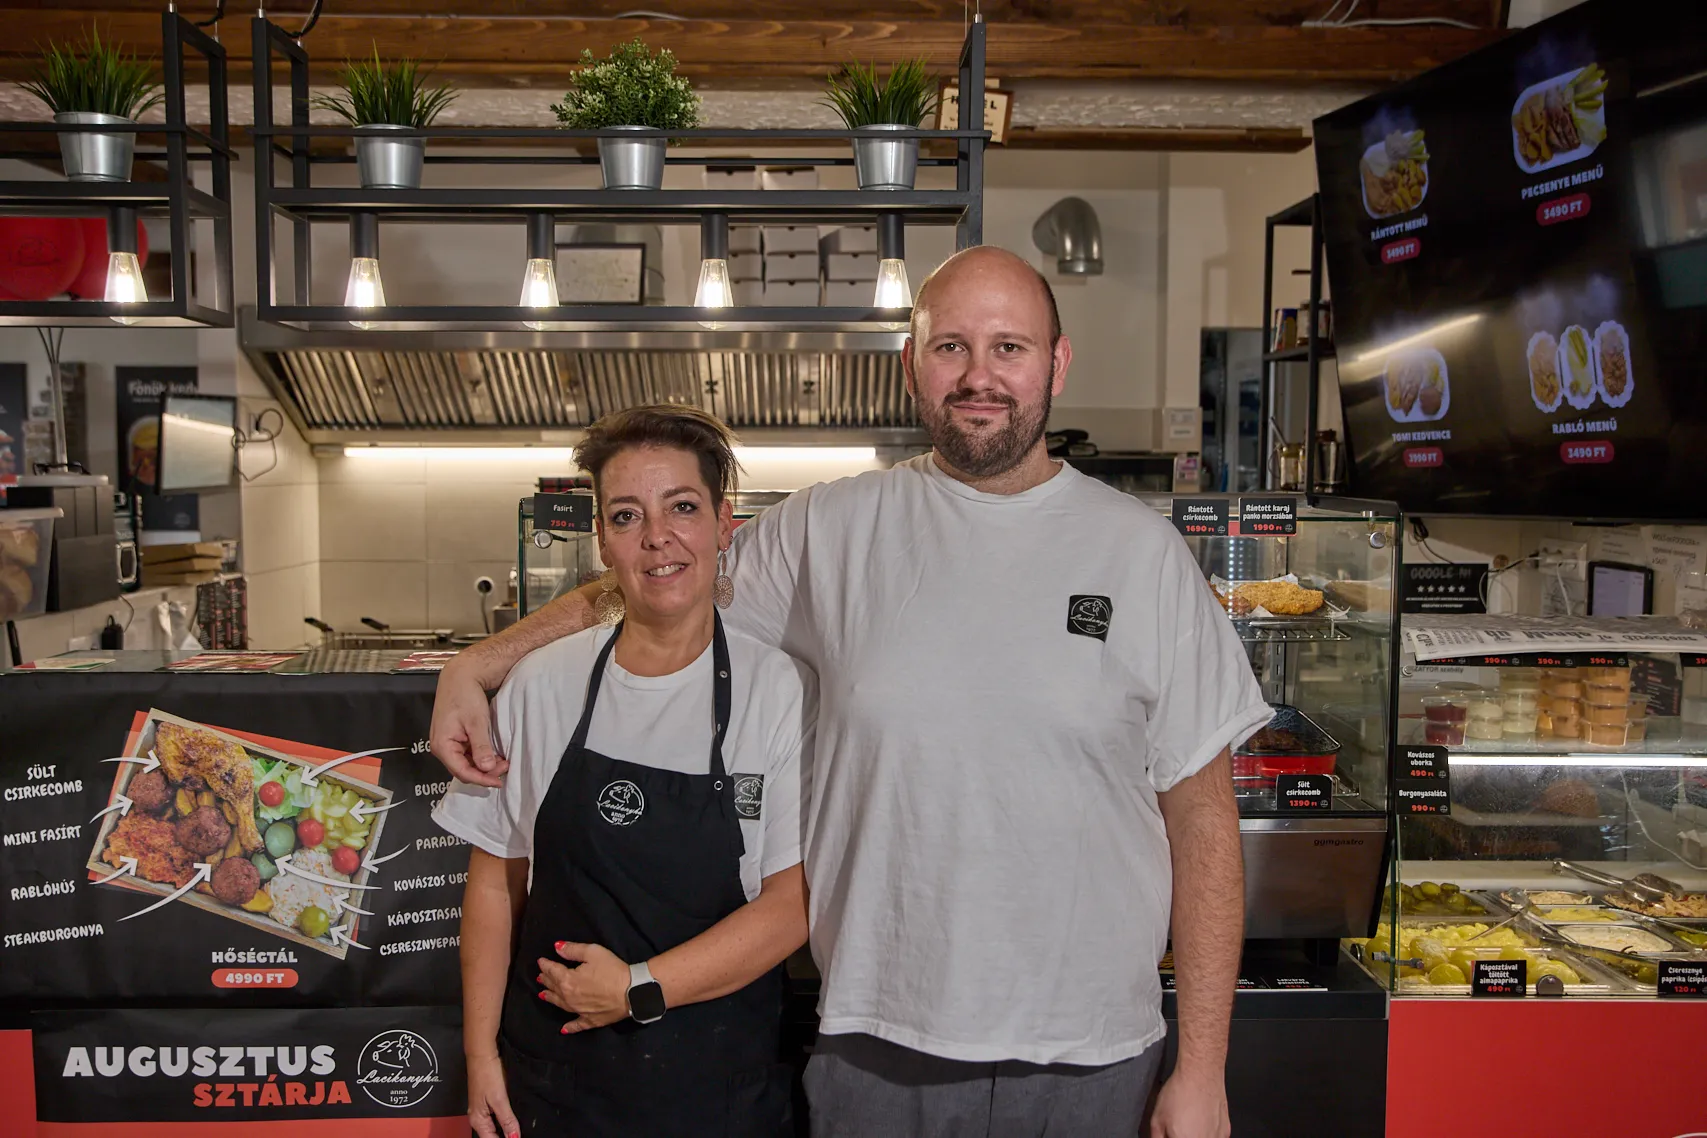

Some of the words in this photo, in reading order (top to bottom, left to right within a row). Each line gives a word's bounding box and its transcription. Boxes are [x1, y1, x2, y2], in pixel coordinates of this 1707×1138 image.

[1521, 176, 1570, 200] PECSENYE
[1543, 205, 1568, 220] 3490
[1570, 200, 1582, 212] FT
[1371, 222, 1404, 241] RÁNTOTT
[1405, 243, 1414, 255] FT
[1552, 418, 1585, 434] RABLÓ
[1392, 432, 1411, 442] TOMI
[1412, 430, 1451, 441] KEDVENCE
[1428, 452, 1437, 462] FT
[1568, 447, 1592, 458] 3490
[1593, 446, 1606, 457] FT
[1188, 505, 1214, 513] Rántott
[1246, 504, 1271, 512] Rántott
[1272, 504, 1290, 513] karaj
[1243, 513, 1260, 521] panko
[1262, 512, 1293, 520] morzsában
[1537, 657, 1553, 665] 390
[411, 739, 431, 754] JÉG
[27, 764, 56, 780] SÜLT
[4, 779, 83, 801] CSIRKECOMB
[1297, 780, 1310, 788] Sült
[1398, 789, 1447, 799] Burgonyasaláta
[3, 831, 37, 846] MINI
[40, 824, 82, 841] FASÍRT
[416, 835, 470, 850] PARADIC
[394, 875, 445, 891] KOVÁSZOS
[448, 872, 469, 884] UBO
[11, 880, 76, 900] RABLÓHÚS
[388, 907, 462, 926] KÁPOSZTASA
[4, 923, 104, 948] STEAKBURGONYA
[380, 936, 460, 956] CSERESZNYEPA
[212, 948, 298, 964] HŐSÉGTÁL
[1480, 963, 1518, 972] Káposztával
[1488, 970, 1510, 978] töltött
[1668, 966, 1703, 975] Cseresznye
[225, 973, 263, 984] 4990
[266, 973, 285, 984] FT
[1479, 977, 1518, 985] almapaprika
[1661, 976, 1686, 984] paprika
[62, 1045, 336, 1078] AUGUSZTUS
[357, 1069, 440, 1088] Lacikonyha
[194, 1075, 352, 1107] SZTÁRJA
[390, 1096, 409, 1104] 1972
